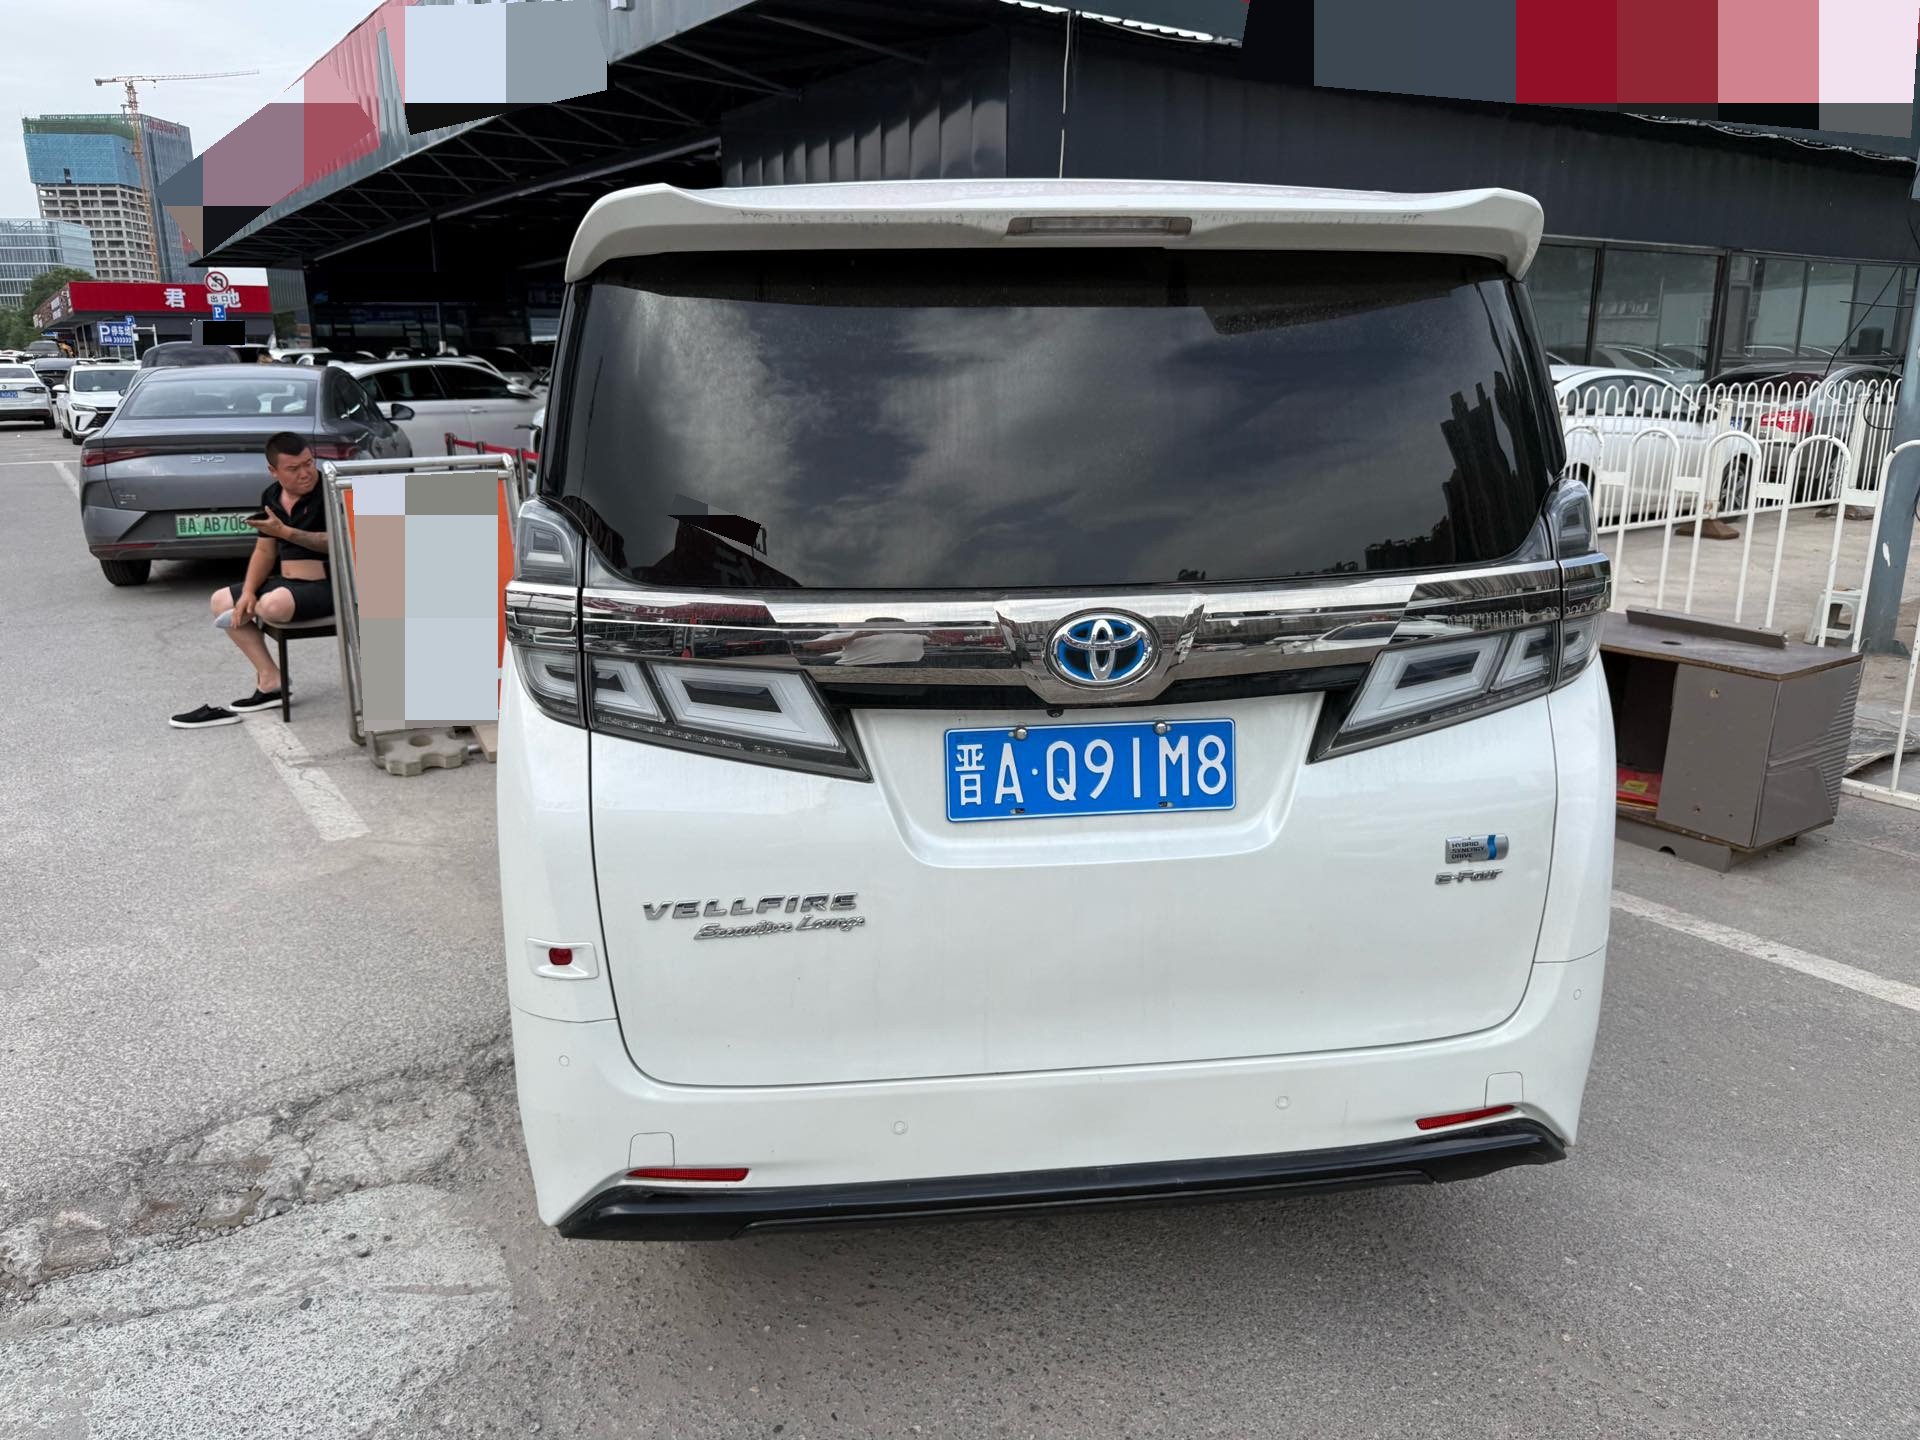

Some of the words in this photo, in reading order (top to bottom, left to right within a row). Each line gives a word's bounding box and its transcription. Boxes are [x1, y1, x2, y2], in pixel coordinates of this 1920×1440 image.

[210, 294, 229, 303] 出口
[99, 324, 111, 343] P
[110, 325, 132, 336] 停车场
[191, 455, 227, 464] BYD
[1451, 846, 1485, 854] SYNERGY
[1451, 852, 1473, 860] DRIVE
[642, 892, 858, 920] VELLFIRE
[693, 919, 793, 940] Executive
[795, 913, 866, 932] Lounge
